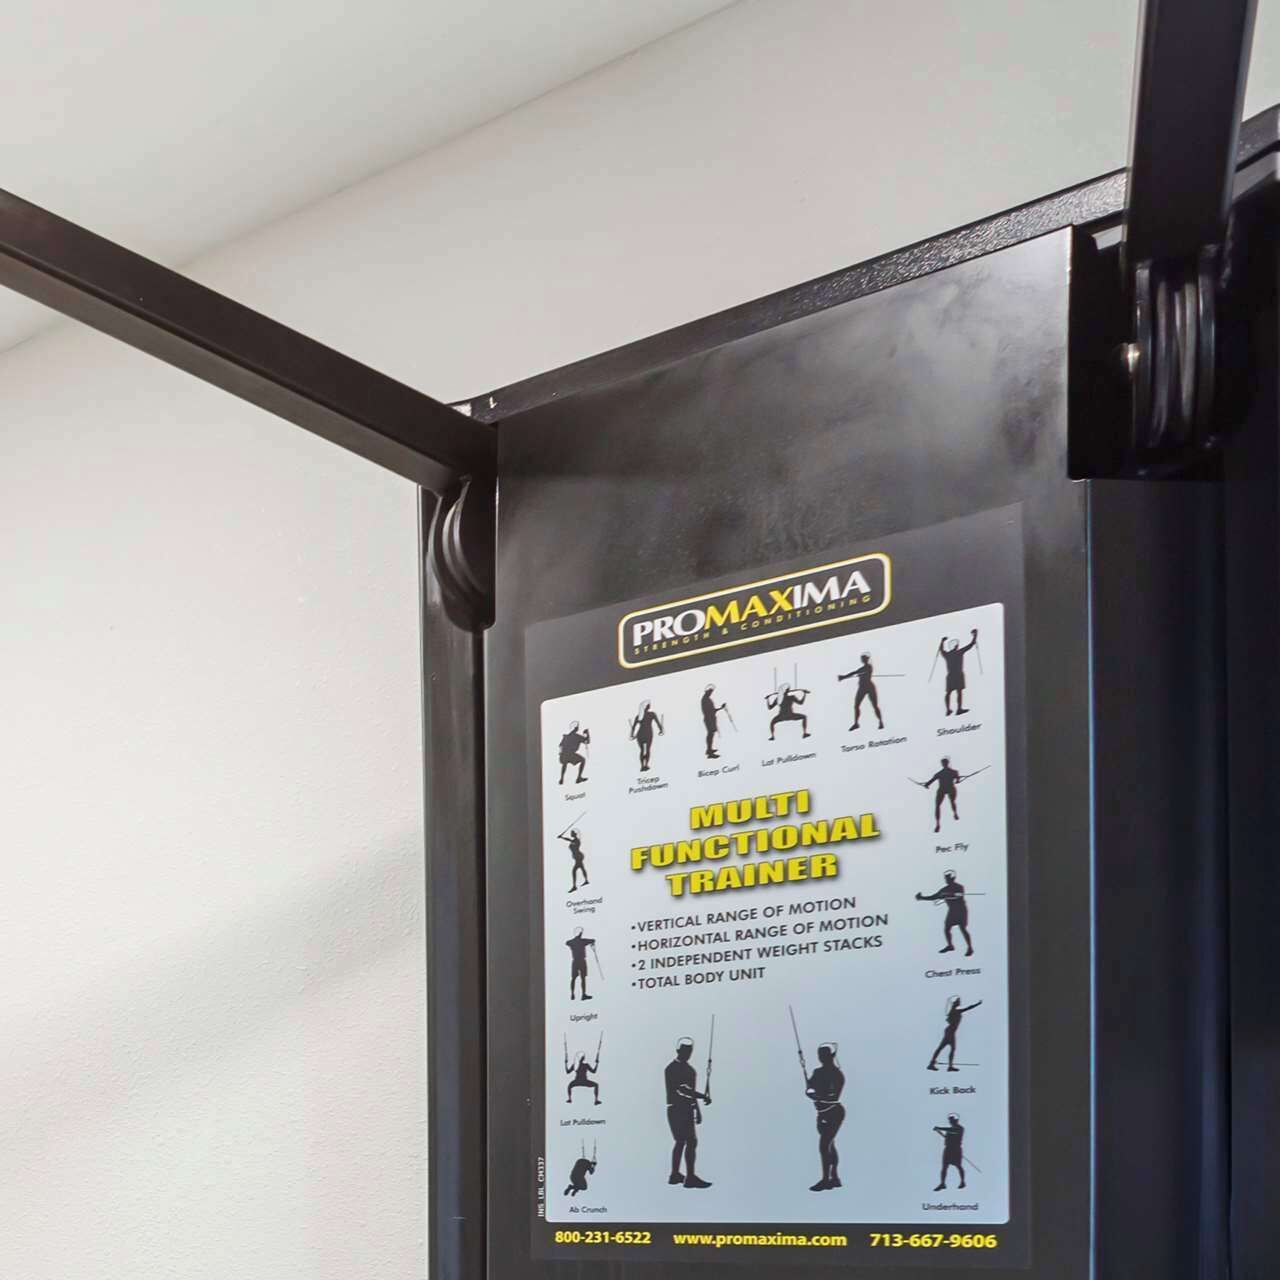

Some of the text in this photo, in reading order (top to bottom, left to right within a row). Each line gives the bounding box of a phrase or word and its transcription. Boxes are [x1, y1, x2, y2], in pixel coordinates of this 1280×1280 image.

[633, 570, 872, 647] PROMAXIMA
[634, 595, 872, 655] STRENGTH & CONDITIONING
[868, 736, 907, 748] Rotation
[937, 722, 982, 737] Shoulder
[698, 767, 720, 778] Bicep
[690, 788, 810, 831] MULTI
[631, 813, 880, 870] FUNCTIONAL
[666, 853, 838, 896] TRAINER
[637, 896, 857, 932] VERTICAL RANGE OF MOTION
[637, 913, 889, 952] HORIZONTAL RANGE OF MOTION
[638, 935, 883, 971] 2 INDEPENDENT WEIGHT STACKS
[638, 966, 766, 990] TOTAL BODY UNIT
[955, 967, 981, 976] Press
[921, 1202, 979, 1212] Underhand
[555, 1231, 998, 1248] 800-231-6522 www.promaxima.com 713-667-9606
